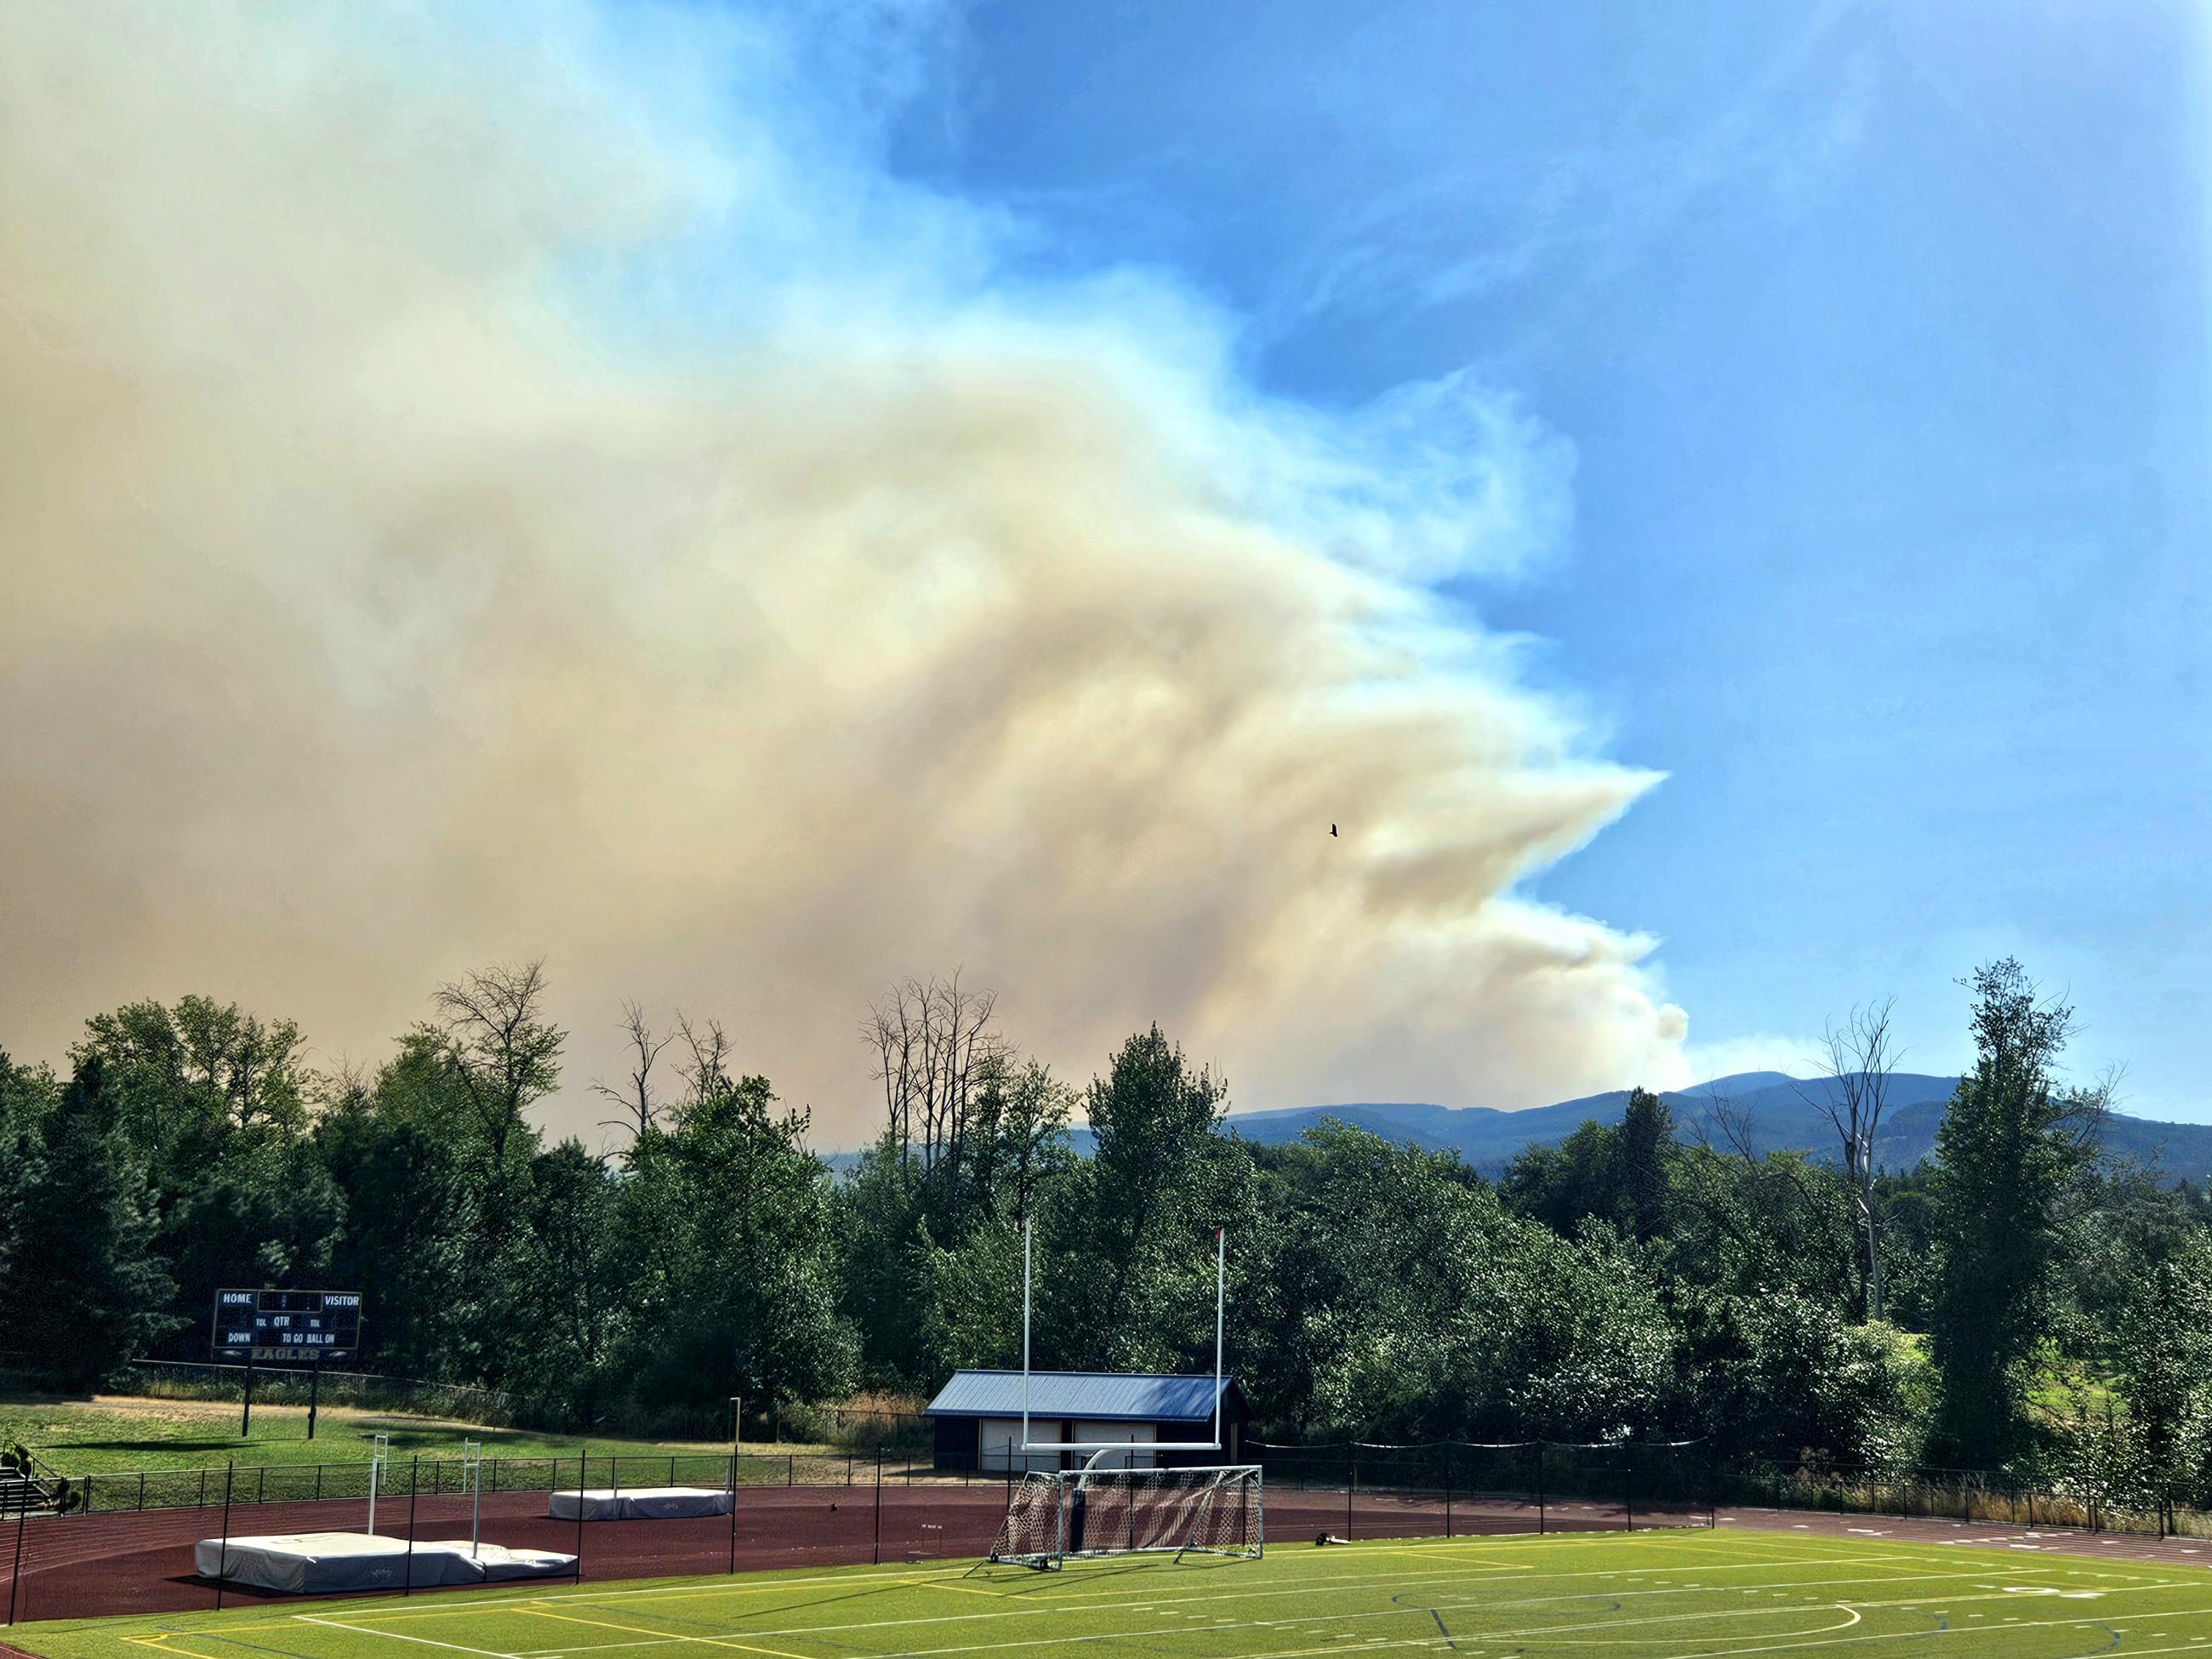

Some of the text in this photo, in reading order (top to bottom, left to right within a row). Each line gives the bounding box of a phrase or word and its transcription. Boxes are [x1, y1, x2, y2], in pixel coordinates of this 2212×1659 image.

[223, 1293, 252, 1303] HOME
[325, 1295, 359, 1306] VISITOR
[274, 1316, 289, 1326] QTR
[228, 1332, 251, 1343] DOWN
[282, 1333, 303, 1343] TO GO
[306, 1333, 335, 1343] BALL ON
[251, 1348, 320, 1360] EAGLES
